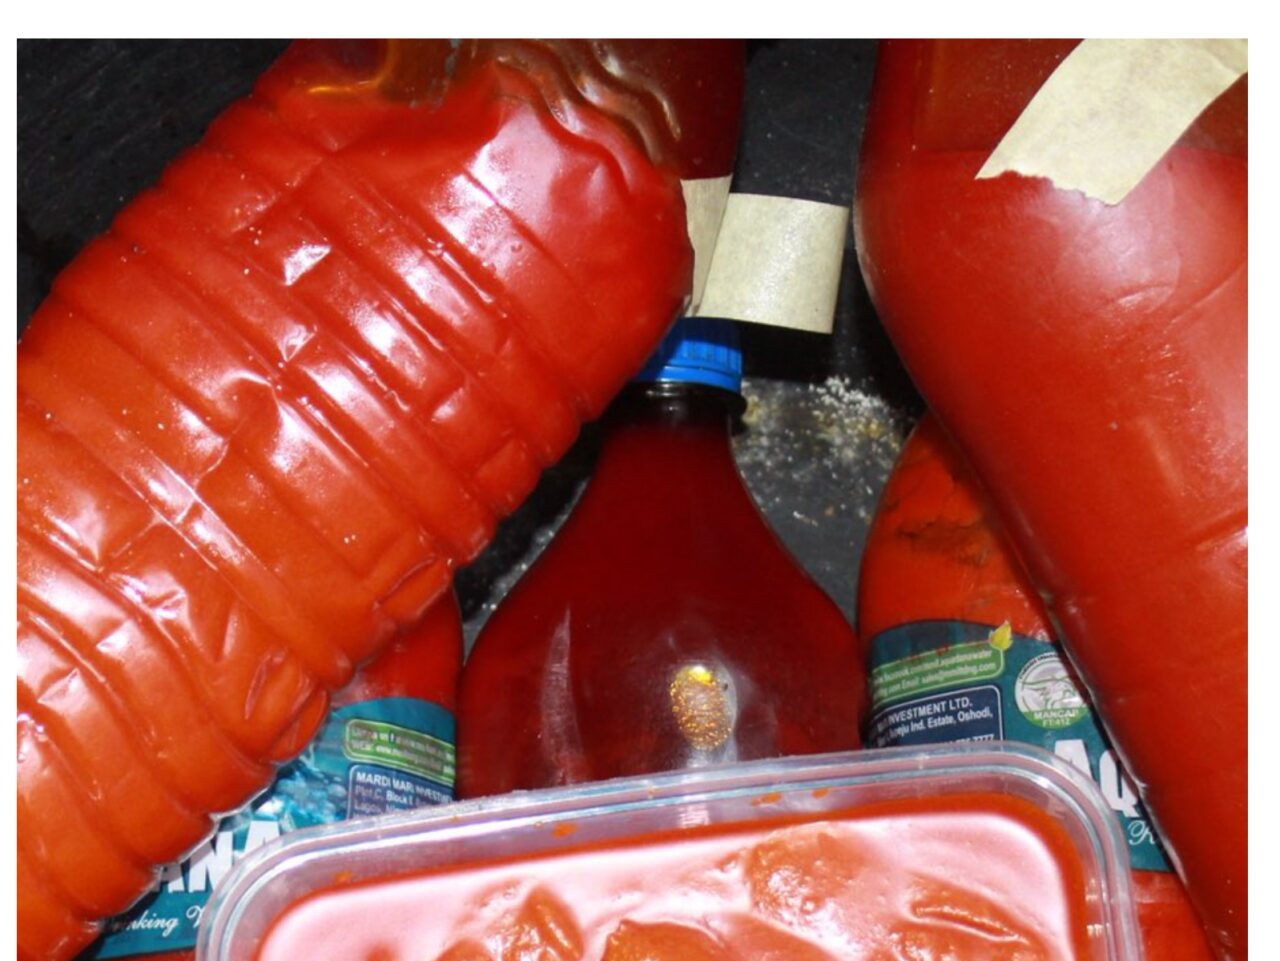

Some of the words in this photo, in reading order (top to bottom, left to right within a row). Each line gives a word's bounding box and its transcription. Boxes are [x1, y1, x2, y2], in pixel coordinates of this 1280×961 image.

[949, 696, 973, 711] LTD.
[957, 705, 993, 722] Oshodi,
[356, 771, 391, 786] MARDI
